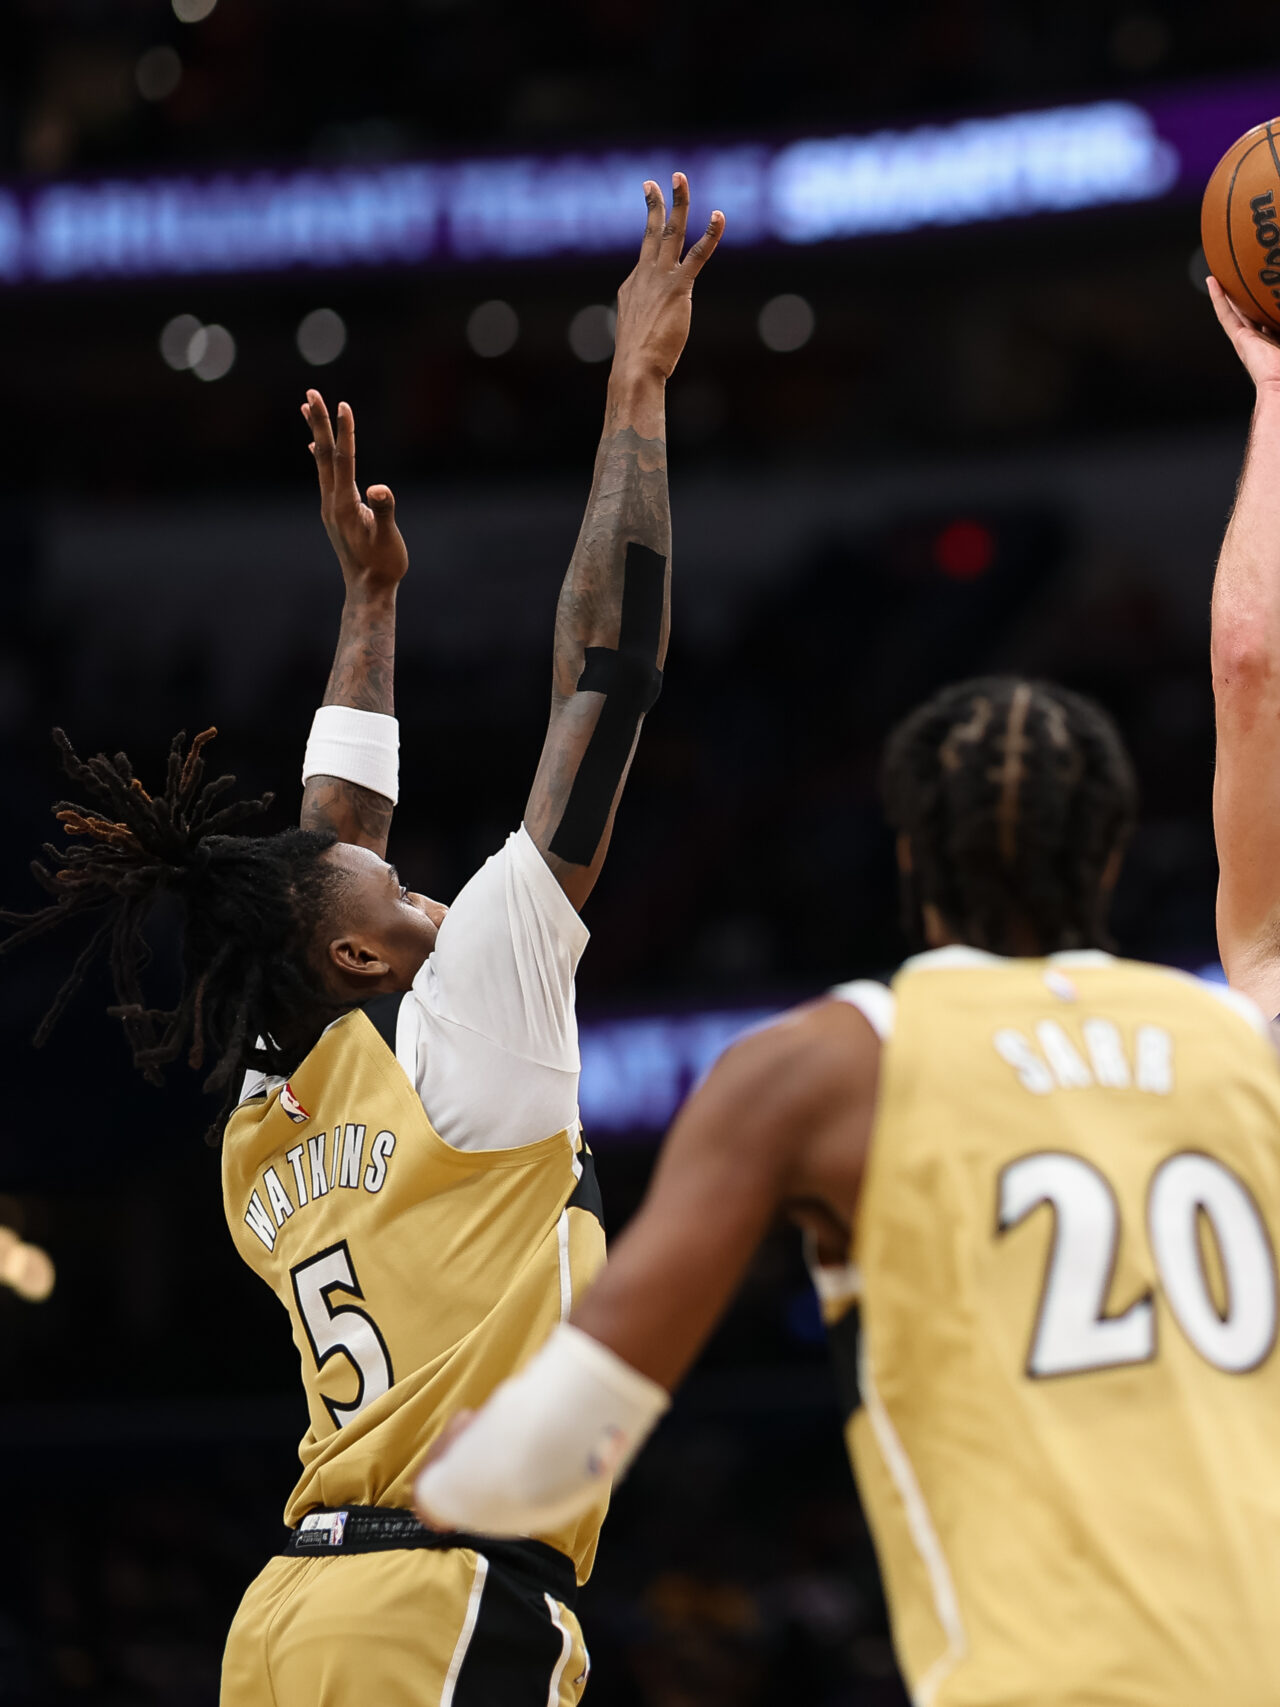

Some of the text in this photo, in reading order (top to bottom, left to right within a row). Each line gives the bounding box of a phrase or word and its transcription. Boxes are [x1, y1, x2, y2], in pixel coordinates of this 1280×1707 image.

[993, 1016, 1175, 1096] SARR
[244, 1122, 397, 1254] WATKINS
[289, 1238, 394, 1430] 5
